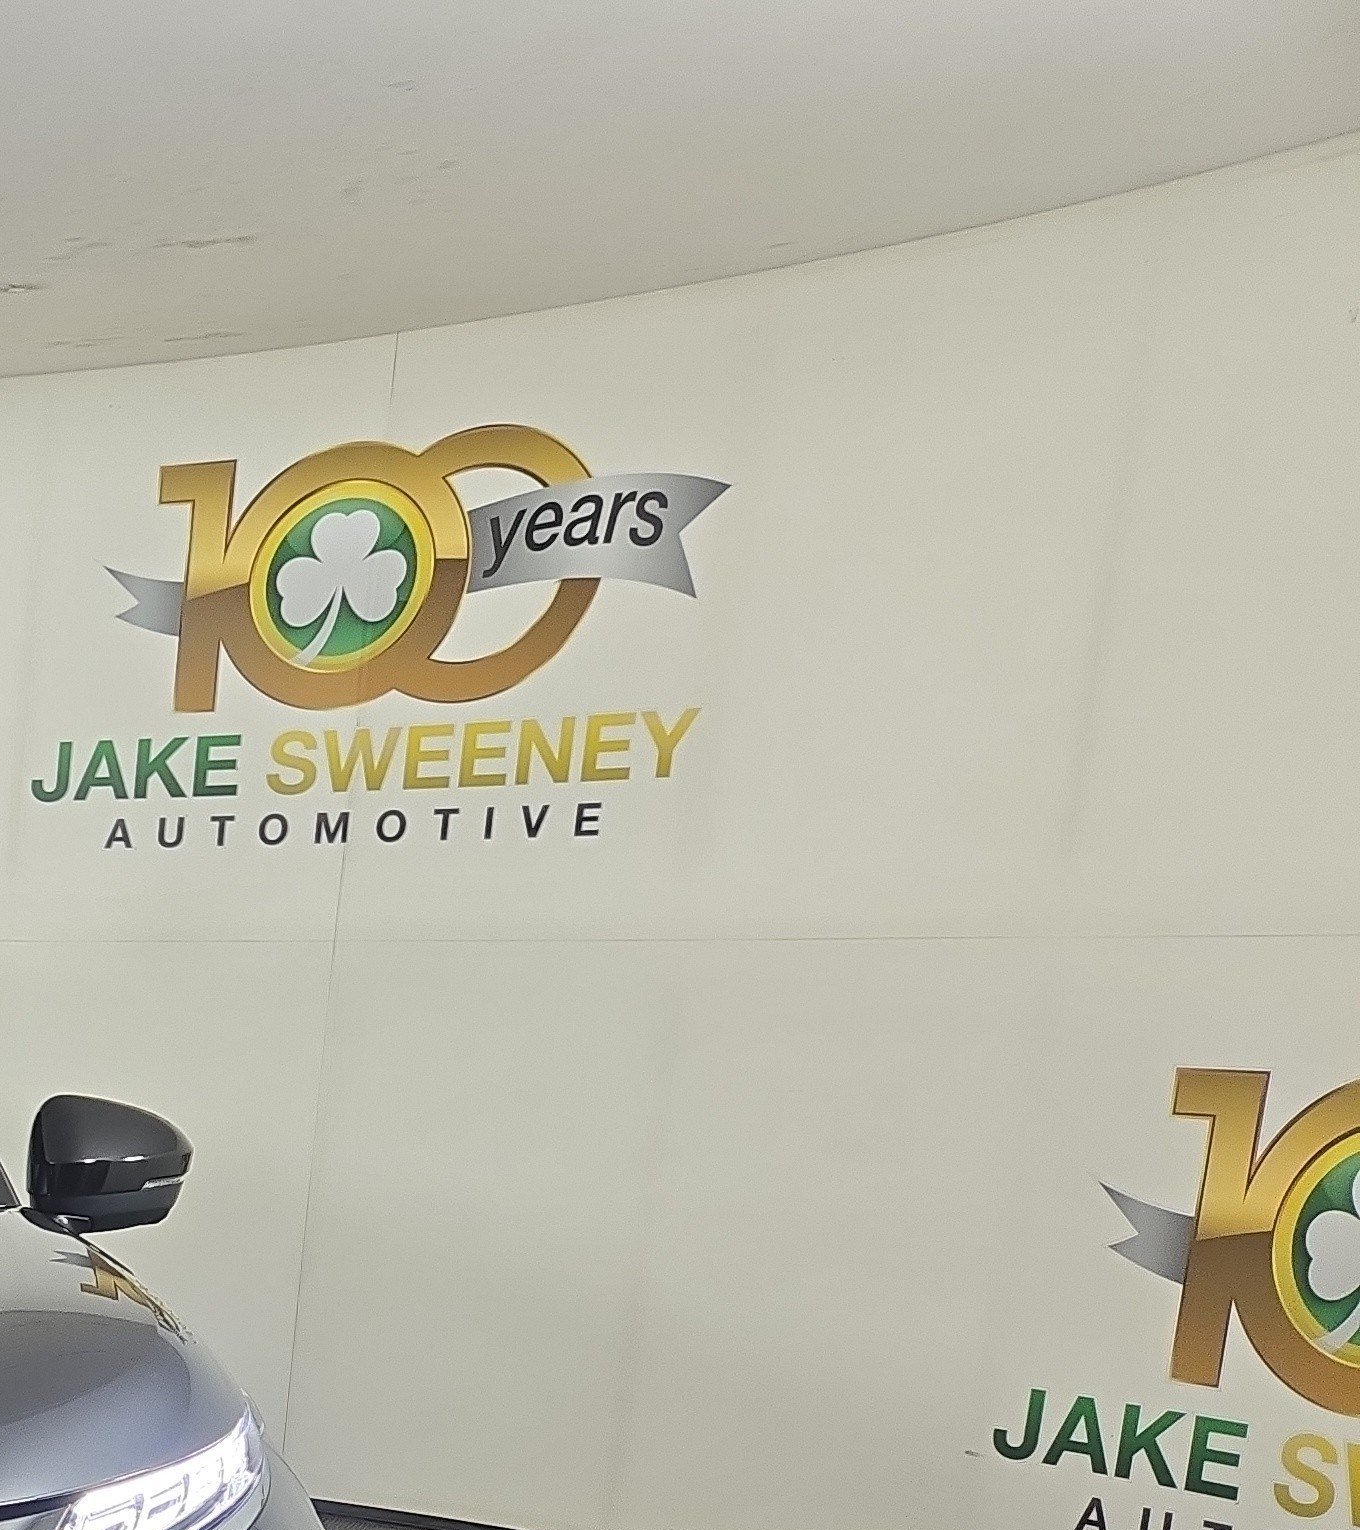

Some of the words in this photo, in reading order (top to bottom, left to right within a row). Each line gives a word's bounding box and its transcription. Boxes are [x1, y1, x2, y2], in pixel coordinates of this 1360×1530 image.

[159, 422, 600, 713] 100
[482, 489, 669, 579] years
[30, 734, 241, 803] JAKE
[266, 707, 701, 795] SWEENEY
[105, 802, 603, 849] AUTOMOTIVE
[992, 1387, 1249, 1501] JAKE
